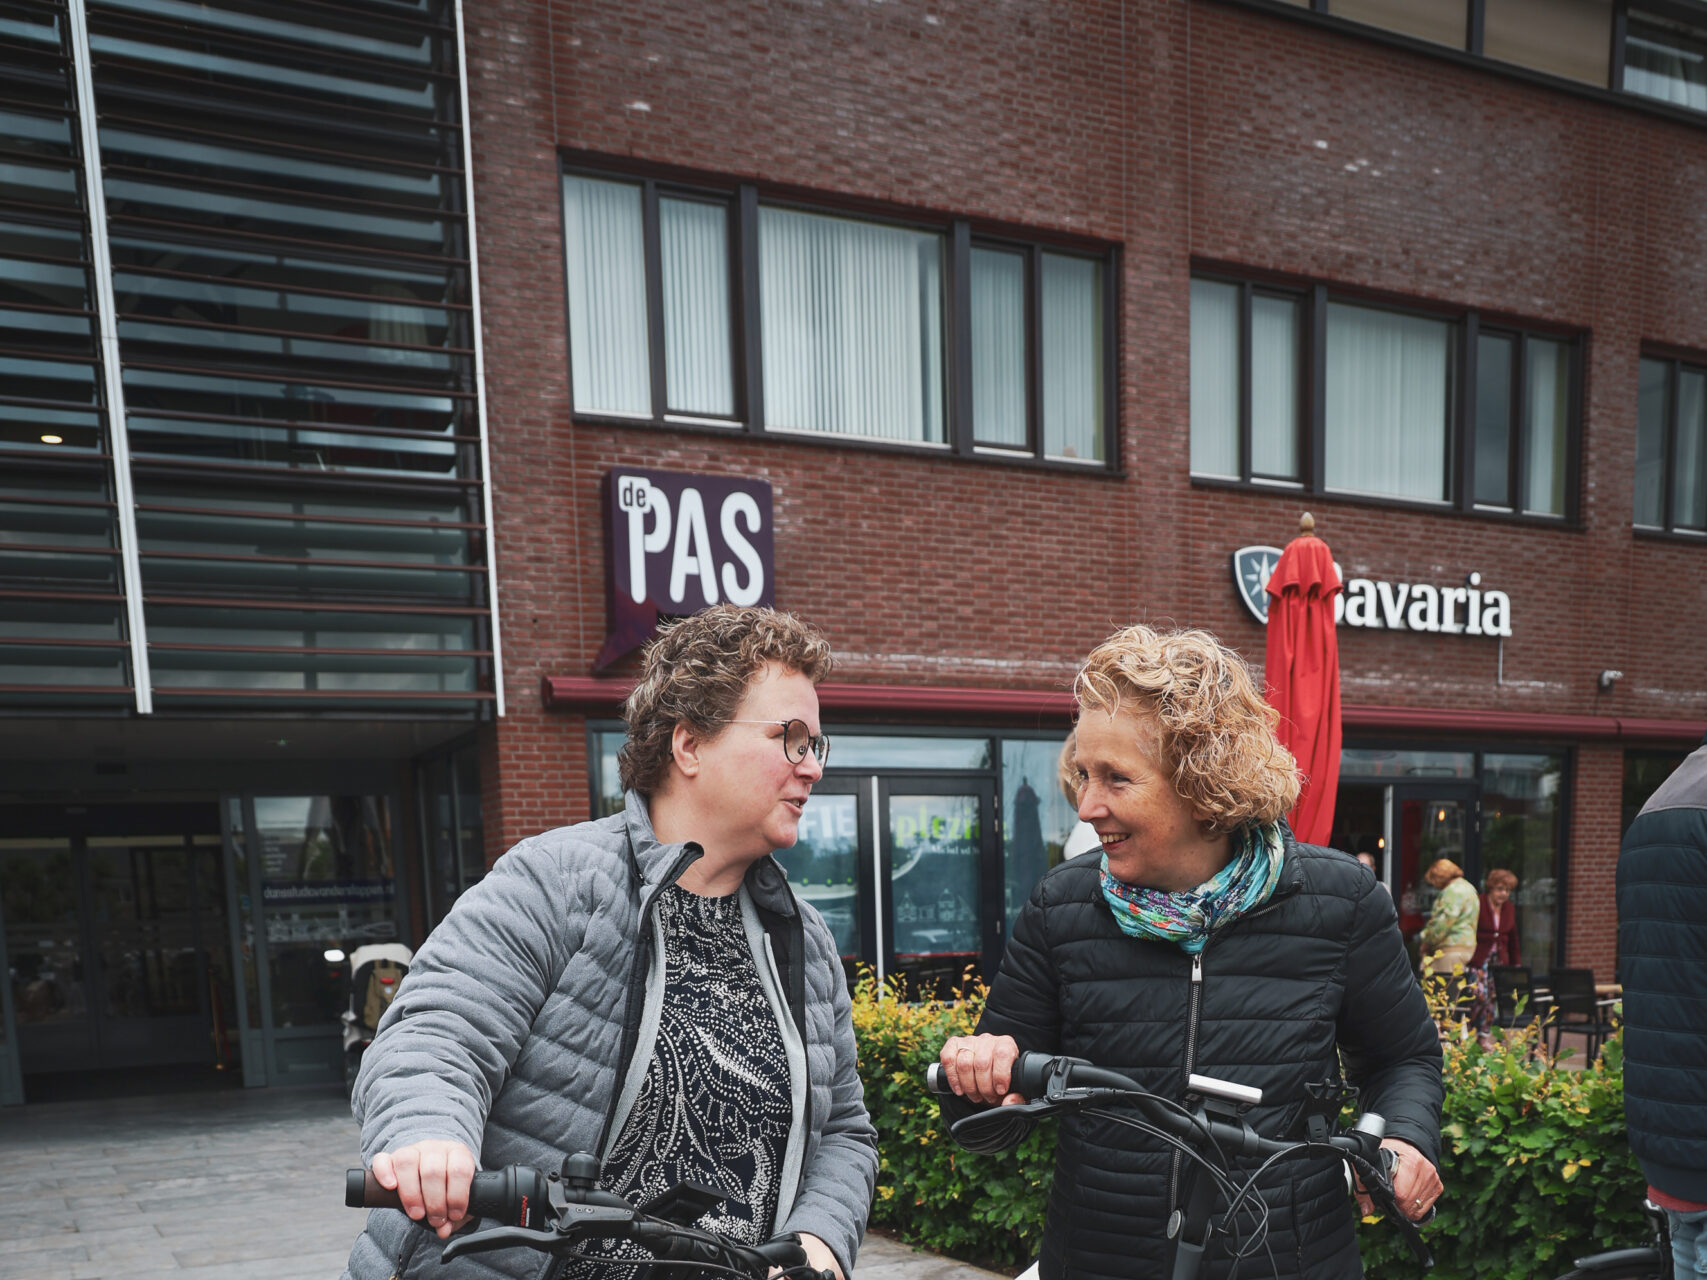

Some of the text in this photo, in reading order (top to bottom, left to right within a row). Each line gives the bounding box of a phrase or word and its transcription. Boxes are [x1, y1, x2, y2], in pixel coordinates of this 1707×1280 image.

[623, 481, 765, 607] de PAS
[1333, 560, 1512, 637] avaria
